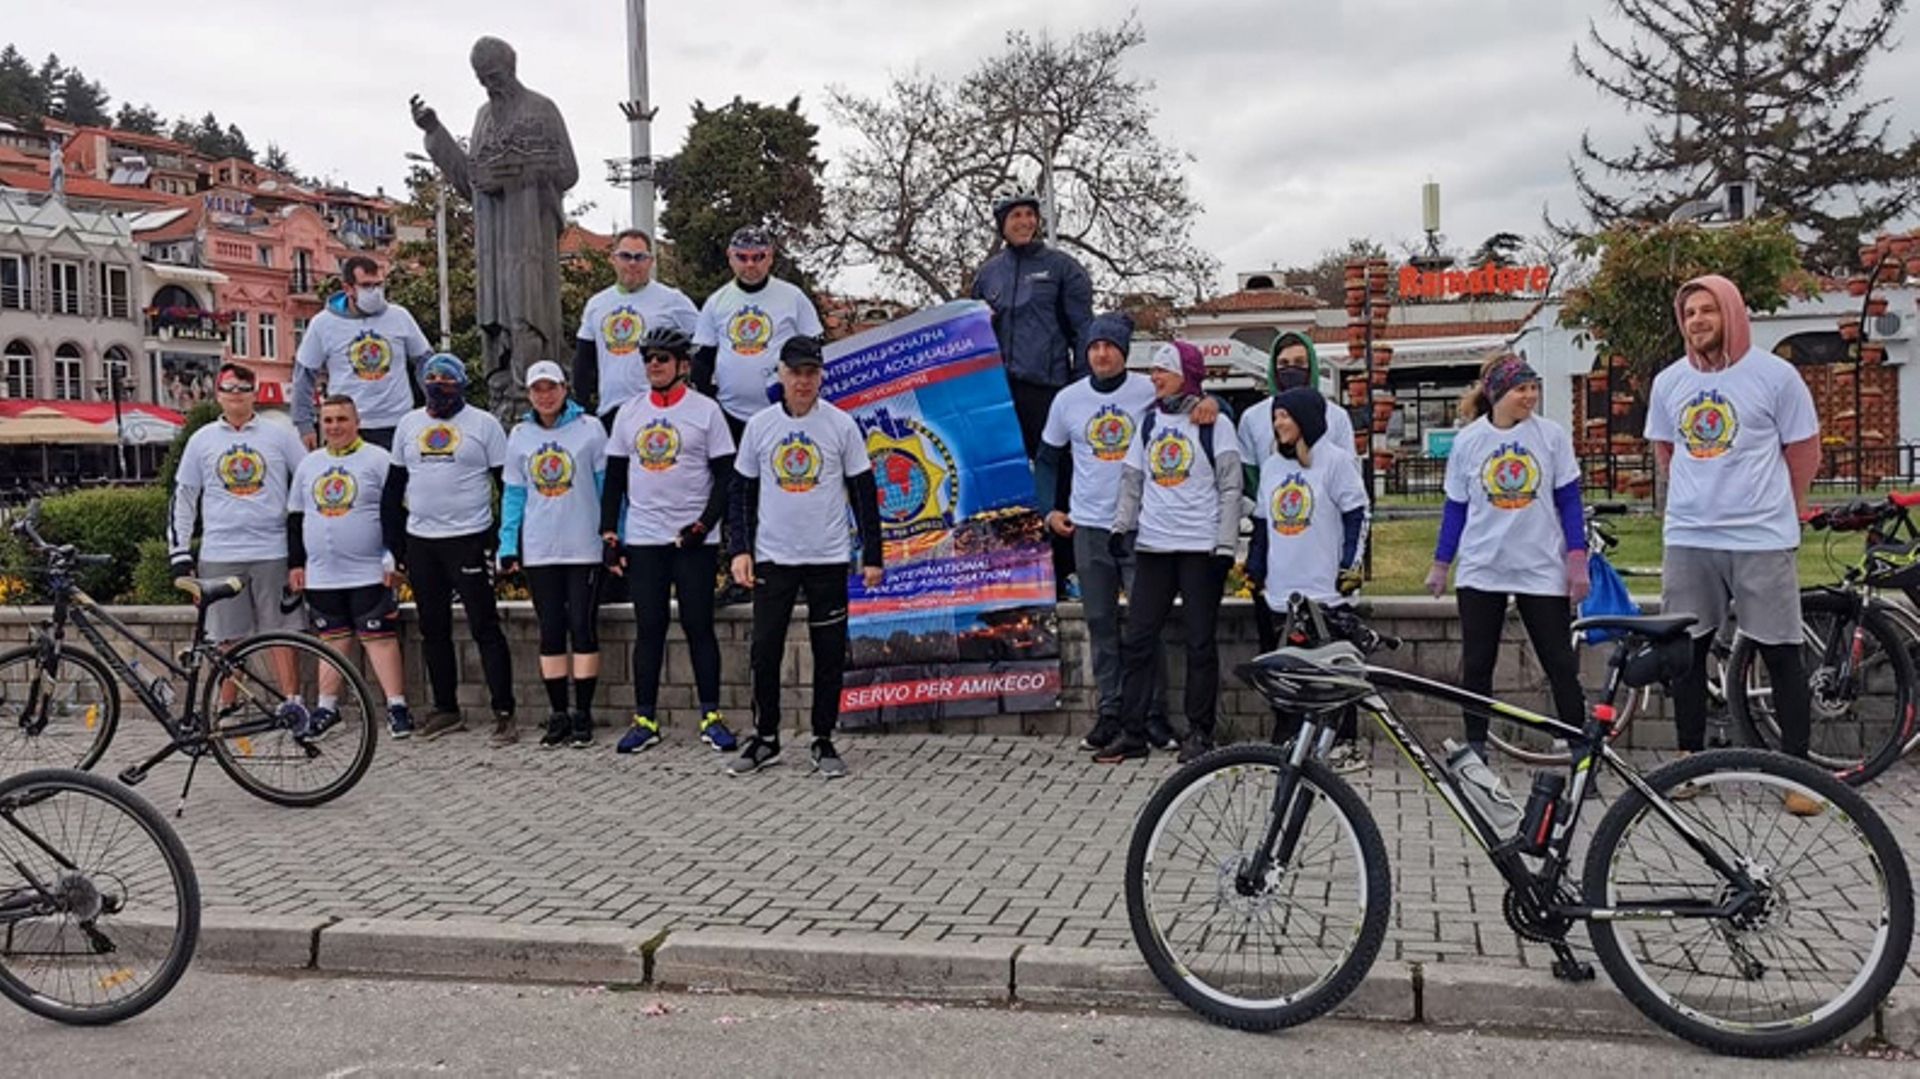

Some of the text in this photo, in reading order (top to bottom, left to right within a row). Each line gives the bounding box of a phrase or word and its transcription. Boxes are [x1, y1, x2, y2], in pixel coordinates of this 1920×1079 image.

[1399, 260, 1549, 298] Ramstore
[864, 569, 1012, 596] POLICE ASSOCIATION
[886, 559, 990, 585] INTERNATIONAL
[845, 672, 1045, 707] SERVO PER AMIKECO
